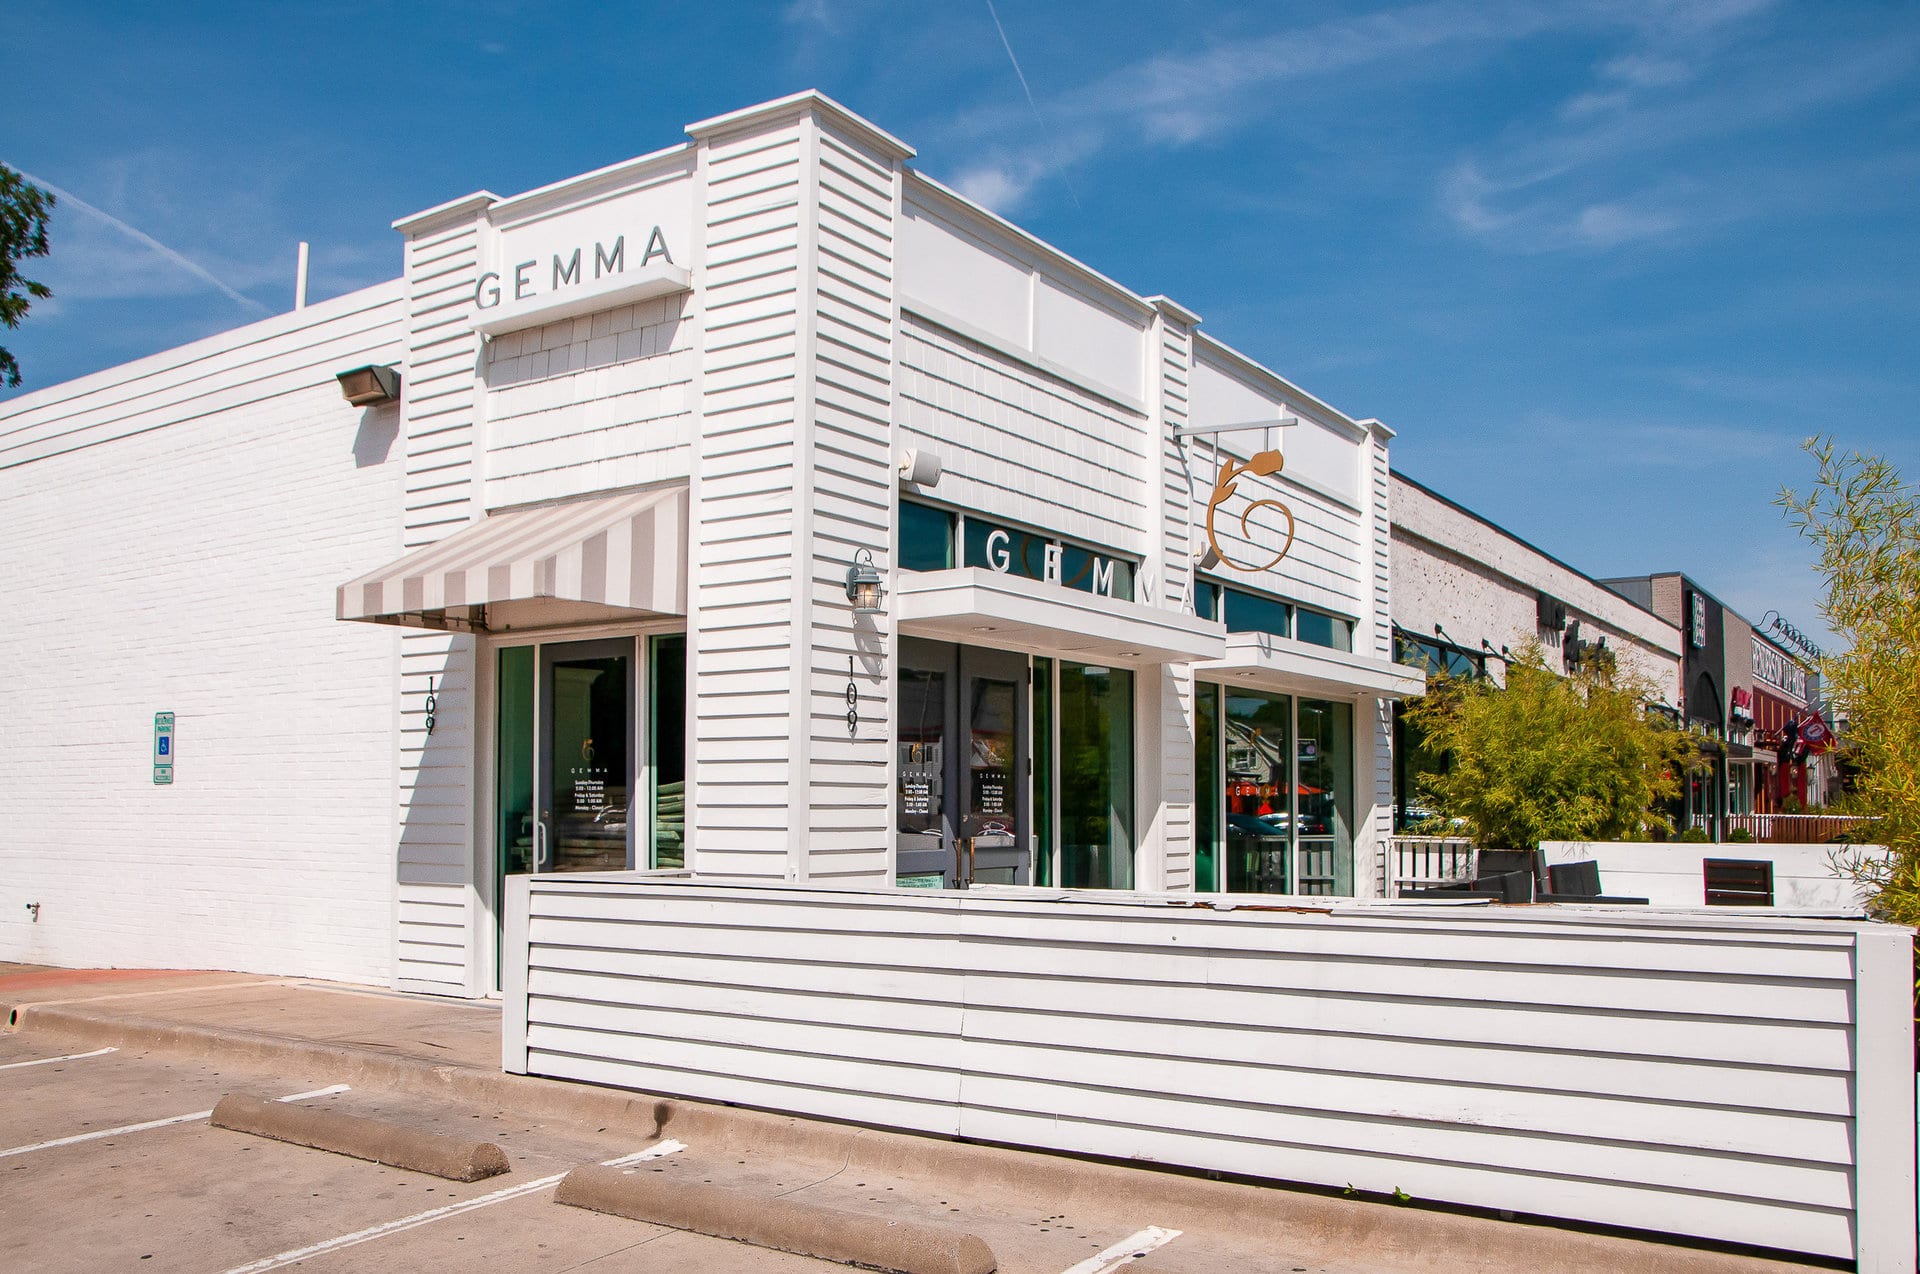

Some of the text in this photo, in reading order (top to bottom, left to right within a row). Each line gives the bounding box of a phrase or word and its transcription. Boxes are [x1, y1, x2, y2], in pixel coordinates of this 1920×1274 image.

[474, 225, 674, 310] GEMMA
[985, 529, 1198, 617] GEMMA
[426, 676, 436, 736] 109
[847, 655, 858, 732] 109
[1235, 786, 1279, 797] GEMMA
